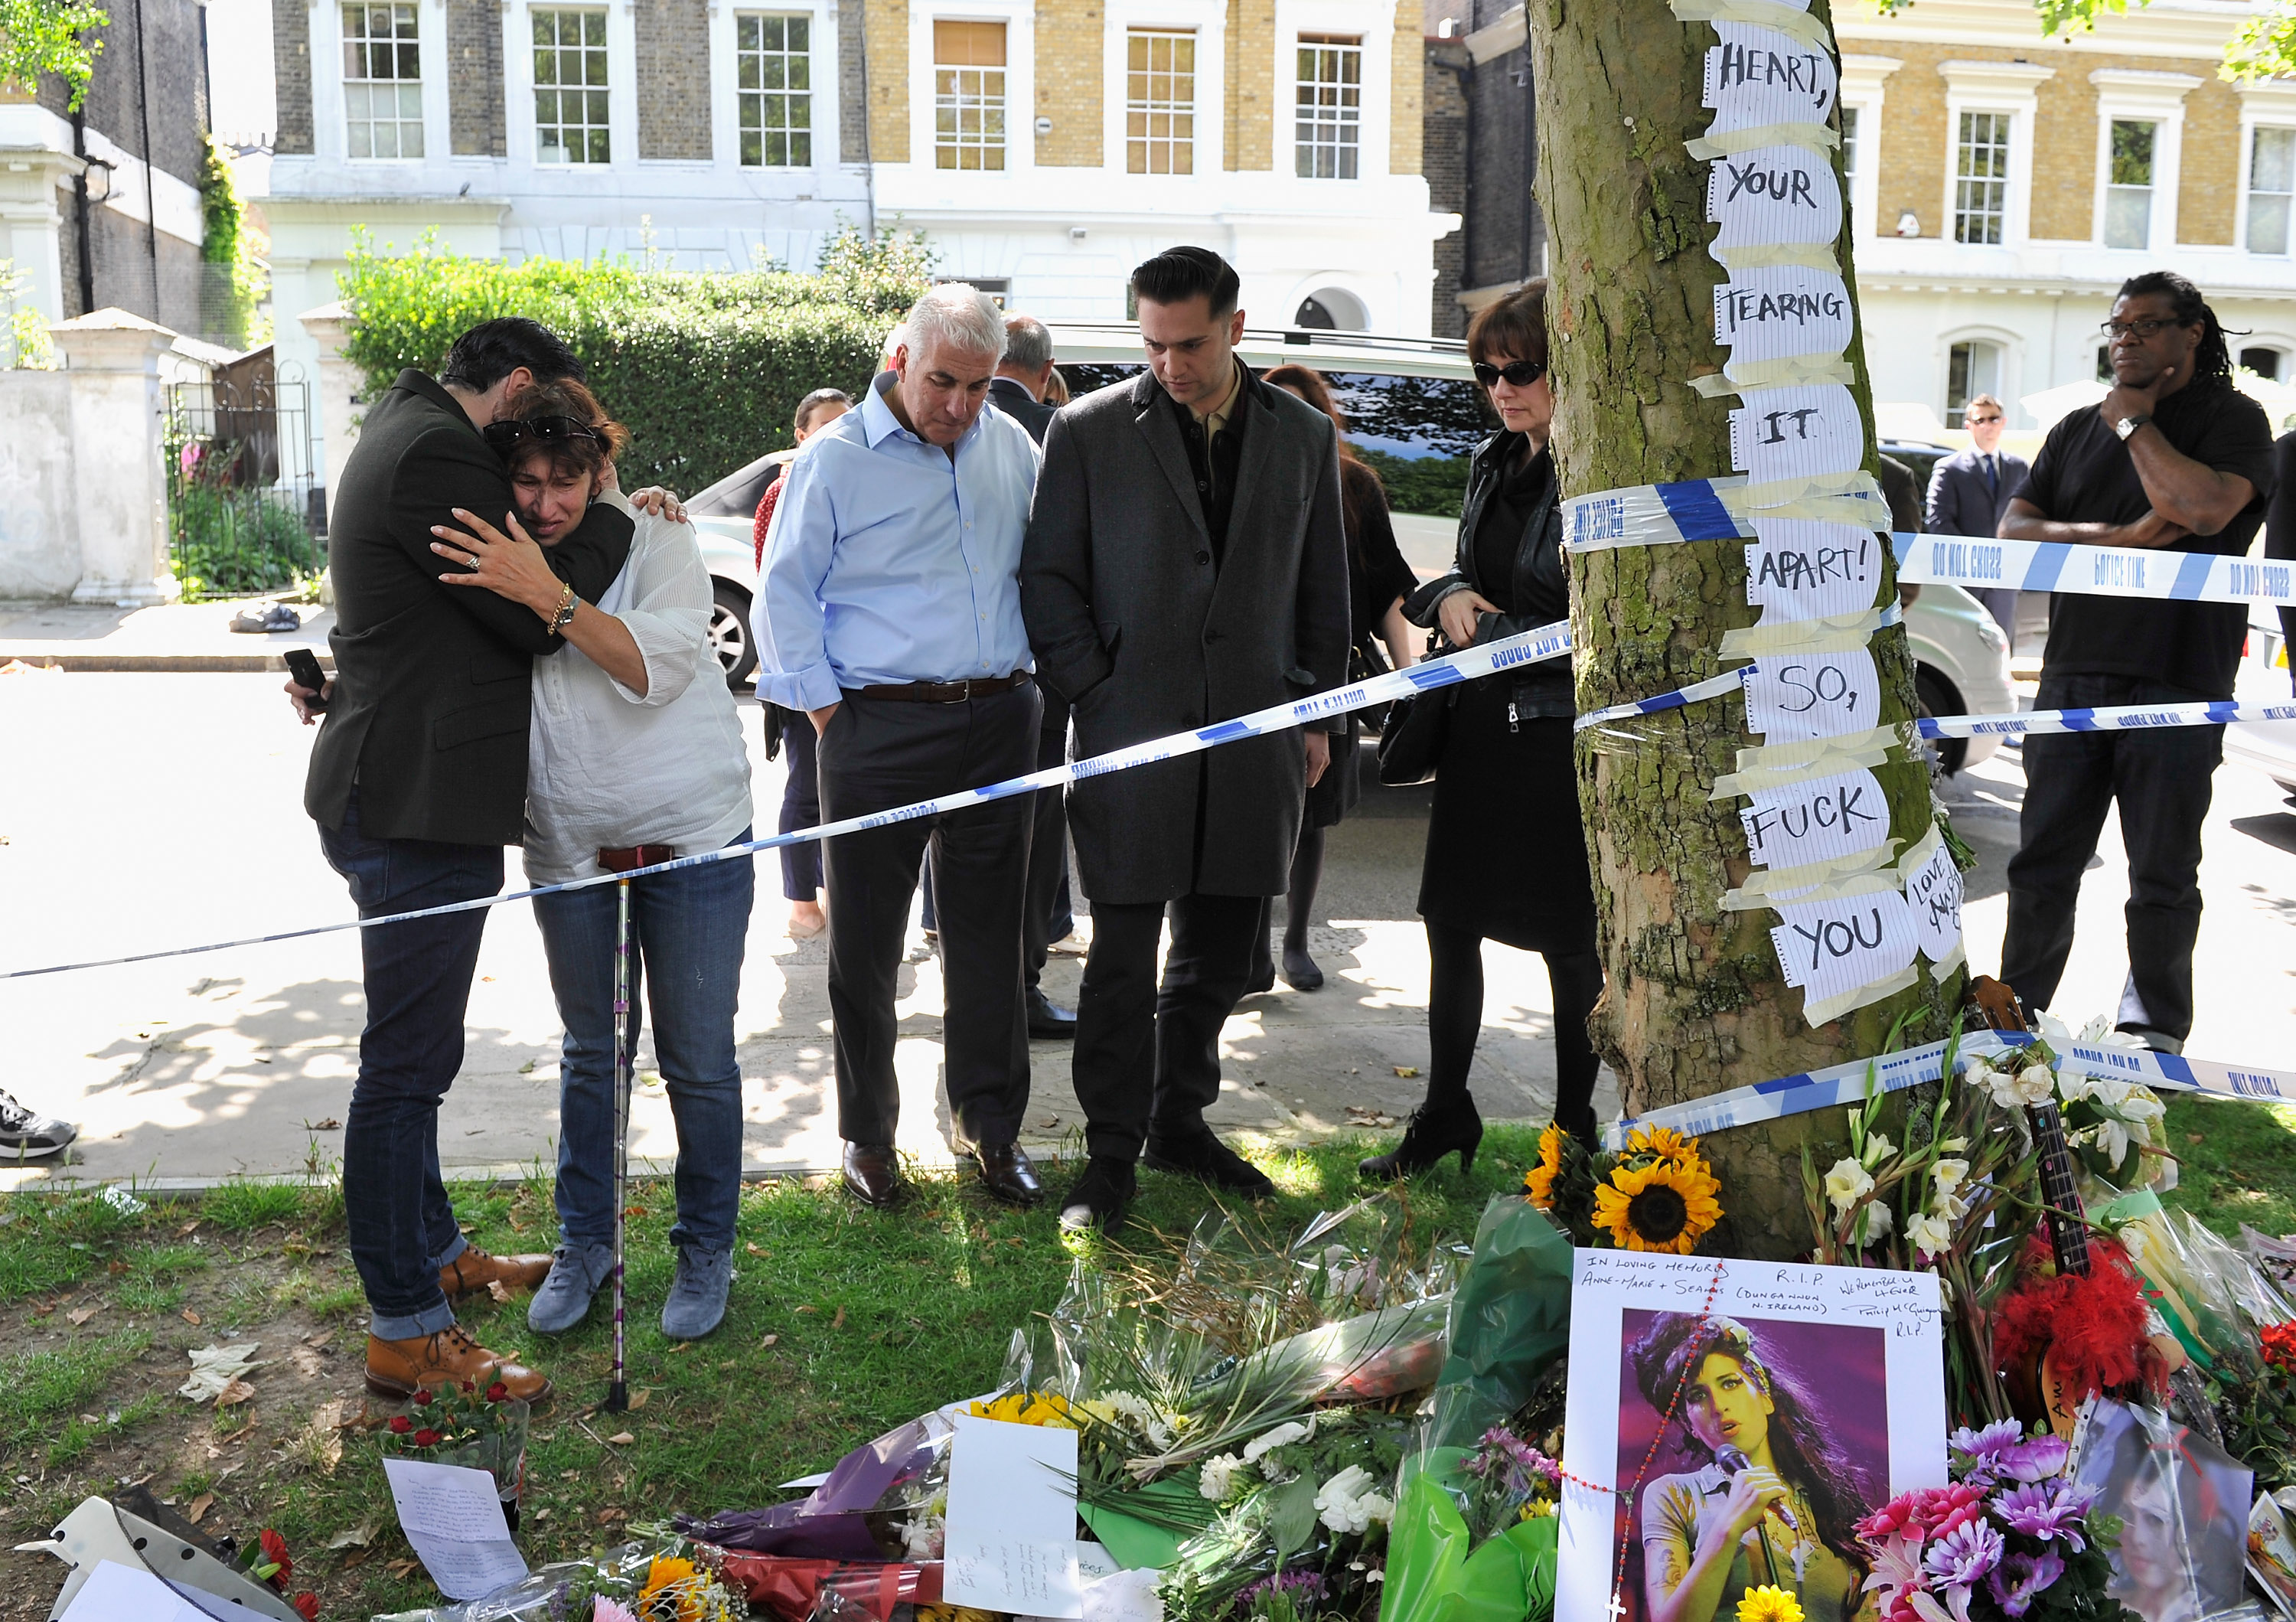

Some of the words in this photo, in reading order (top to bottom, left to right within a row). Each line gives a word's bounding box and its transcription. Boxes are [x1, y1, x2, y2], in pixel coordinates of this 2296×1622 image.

[1720, 41, 1828, 108] HEART,
[1727, 162, 1817, 208] YOUR
[1720, 288, 1844, 333] TEARING
[1756, 409, 1819, 445] IT
[1758, 540, 1867, 589] APART!
[1779, 665, 1858, 710] SO,
[1750, 786, 1877, 849] FUCK
[1913, 852, 1945, 906] LOVE
[1792, 907, 1883, 970] YOU
[1587, 1257, 1608, 1266] IN
[1616, 1259, 1657, 1271] LOVING
